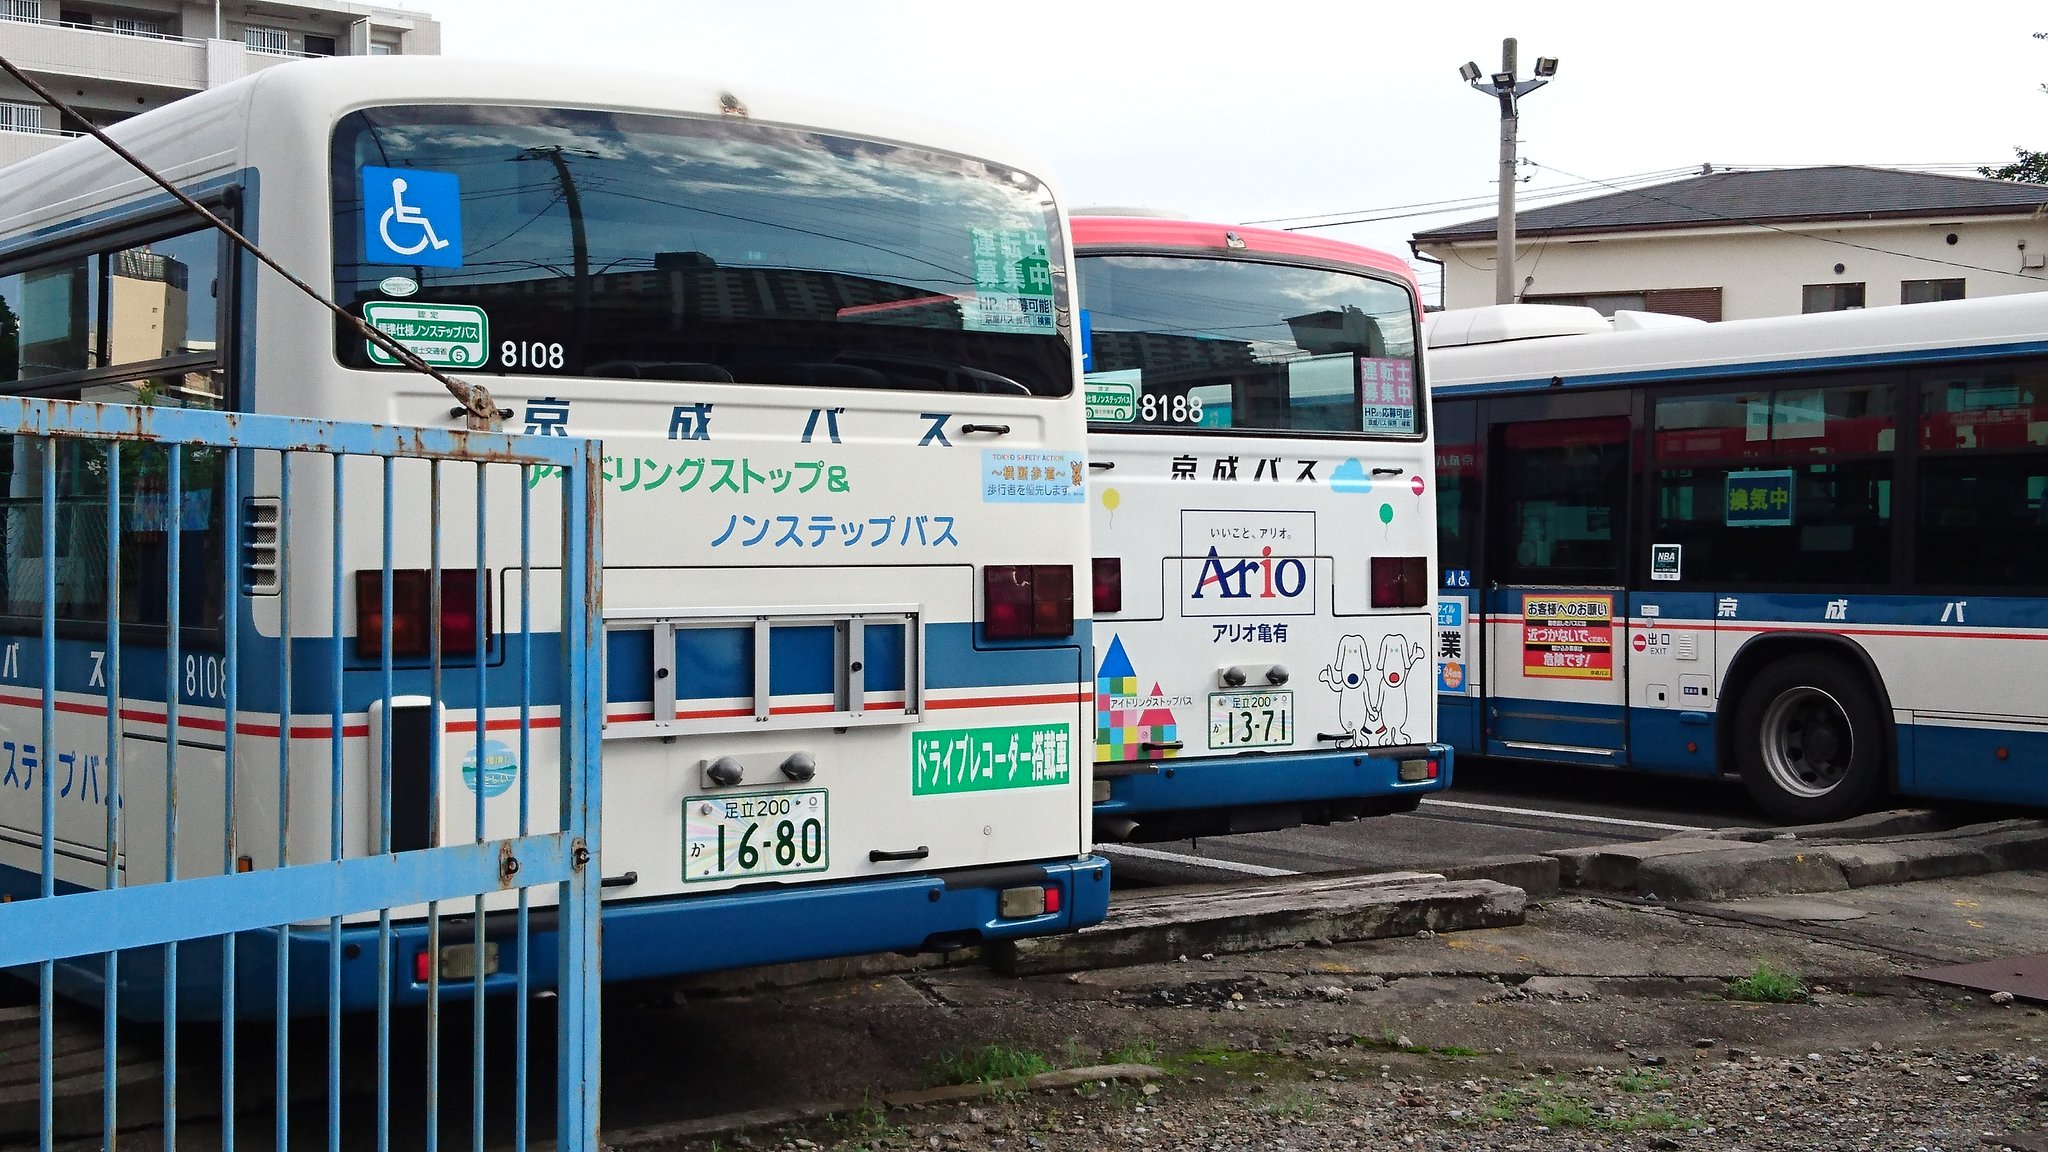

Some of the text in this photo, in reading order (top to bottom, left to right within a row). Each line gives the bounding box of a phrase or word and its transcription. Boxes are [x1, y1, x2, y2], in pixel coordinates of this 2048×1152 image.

[976, 261, 1050, 291] 募集中
[455, 351, 463, 361] 5
[501, 340, 565, 369] 8108
[1141, 394, 1204, 422] 8188
[524, 397, 954, 447] 京成バス
[1171, 455, 1319, 483] 京成バス
[1729, 486, 1789, 511] 換気中
[711, 515, 959, 547] ノンステップバス
[1210, 527, 1292, 540] いいこと、アリオ。
[1657, 552, 1676, 562] NBA
[1191, 545, 1307, 599] Ario
[1528, 603, 1607, 616] お客様へのお願い
[1717, 597, 1966, 623] 京成バ
[1212, 622, 1288, 643] アリオ亀有
[1648, 632, 1670, 646] 出口
[1650, 647, 1667, 655] EXIT
[1213, 723, 1222, 734] か
[917, 730, 1069, 787] ドライブレコーダー搭載車
[690, 818, 823, 872] か 16-80
